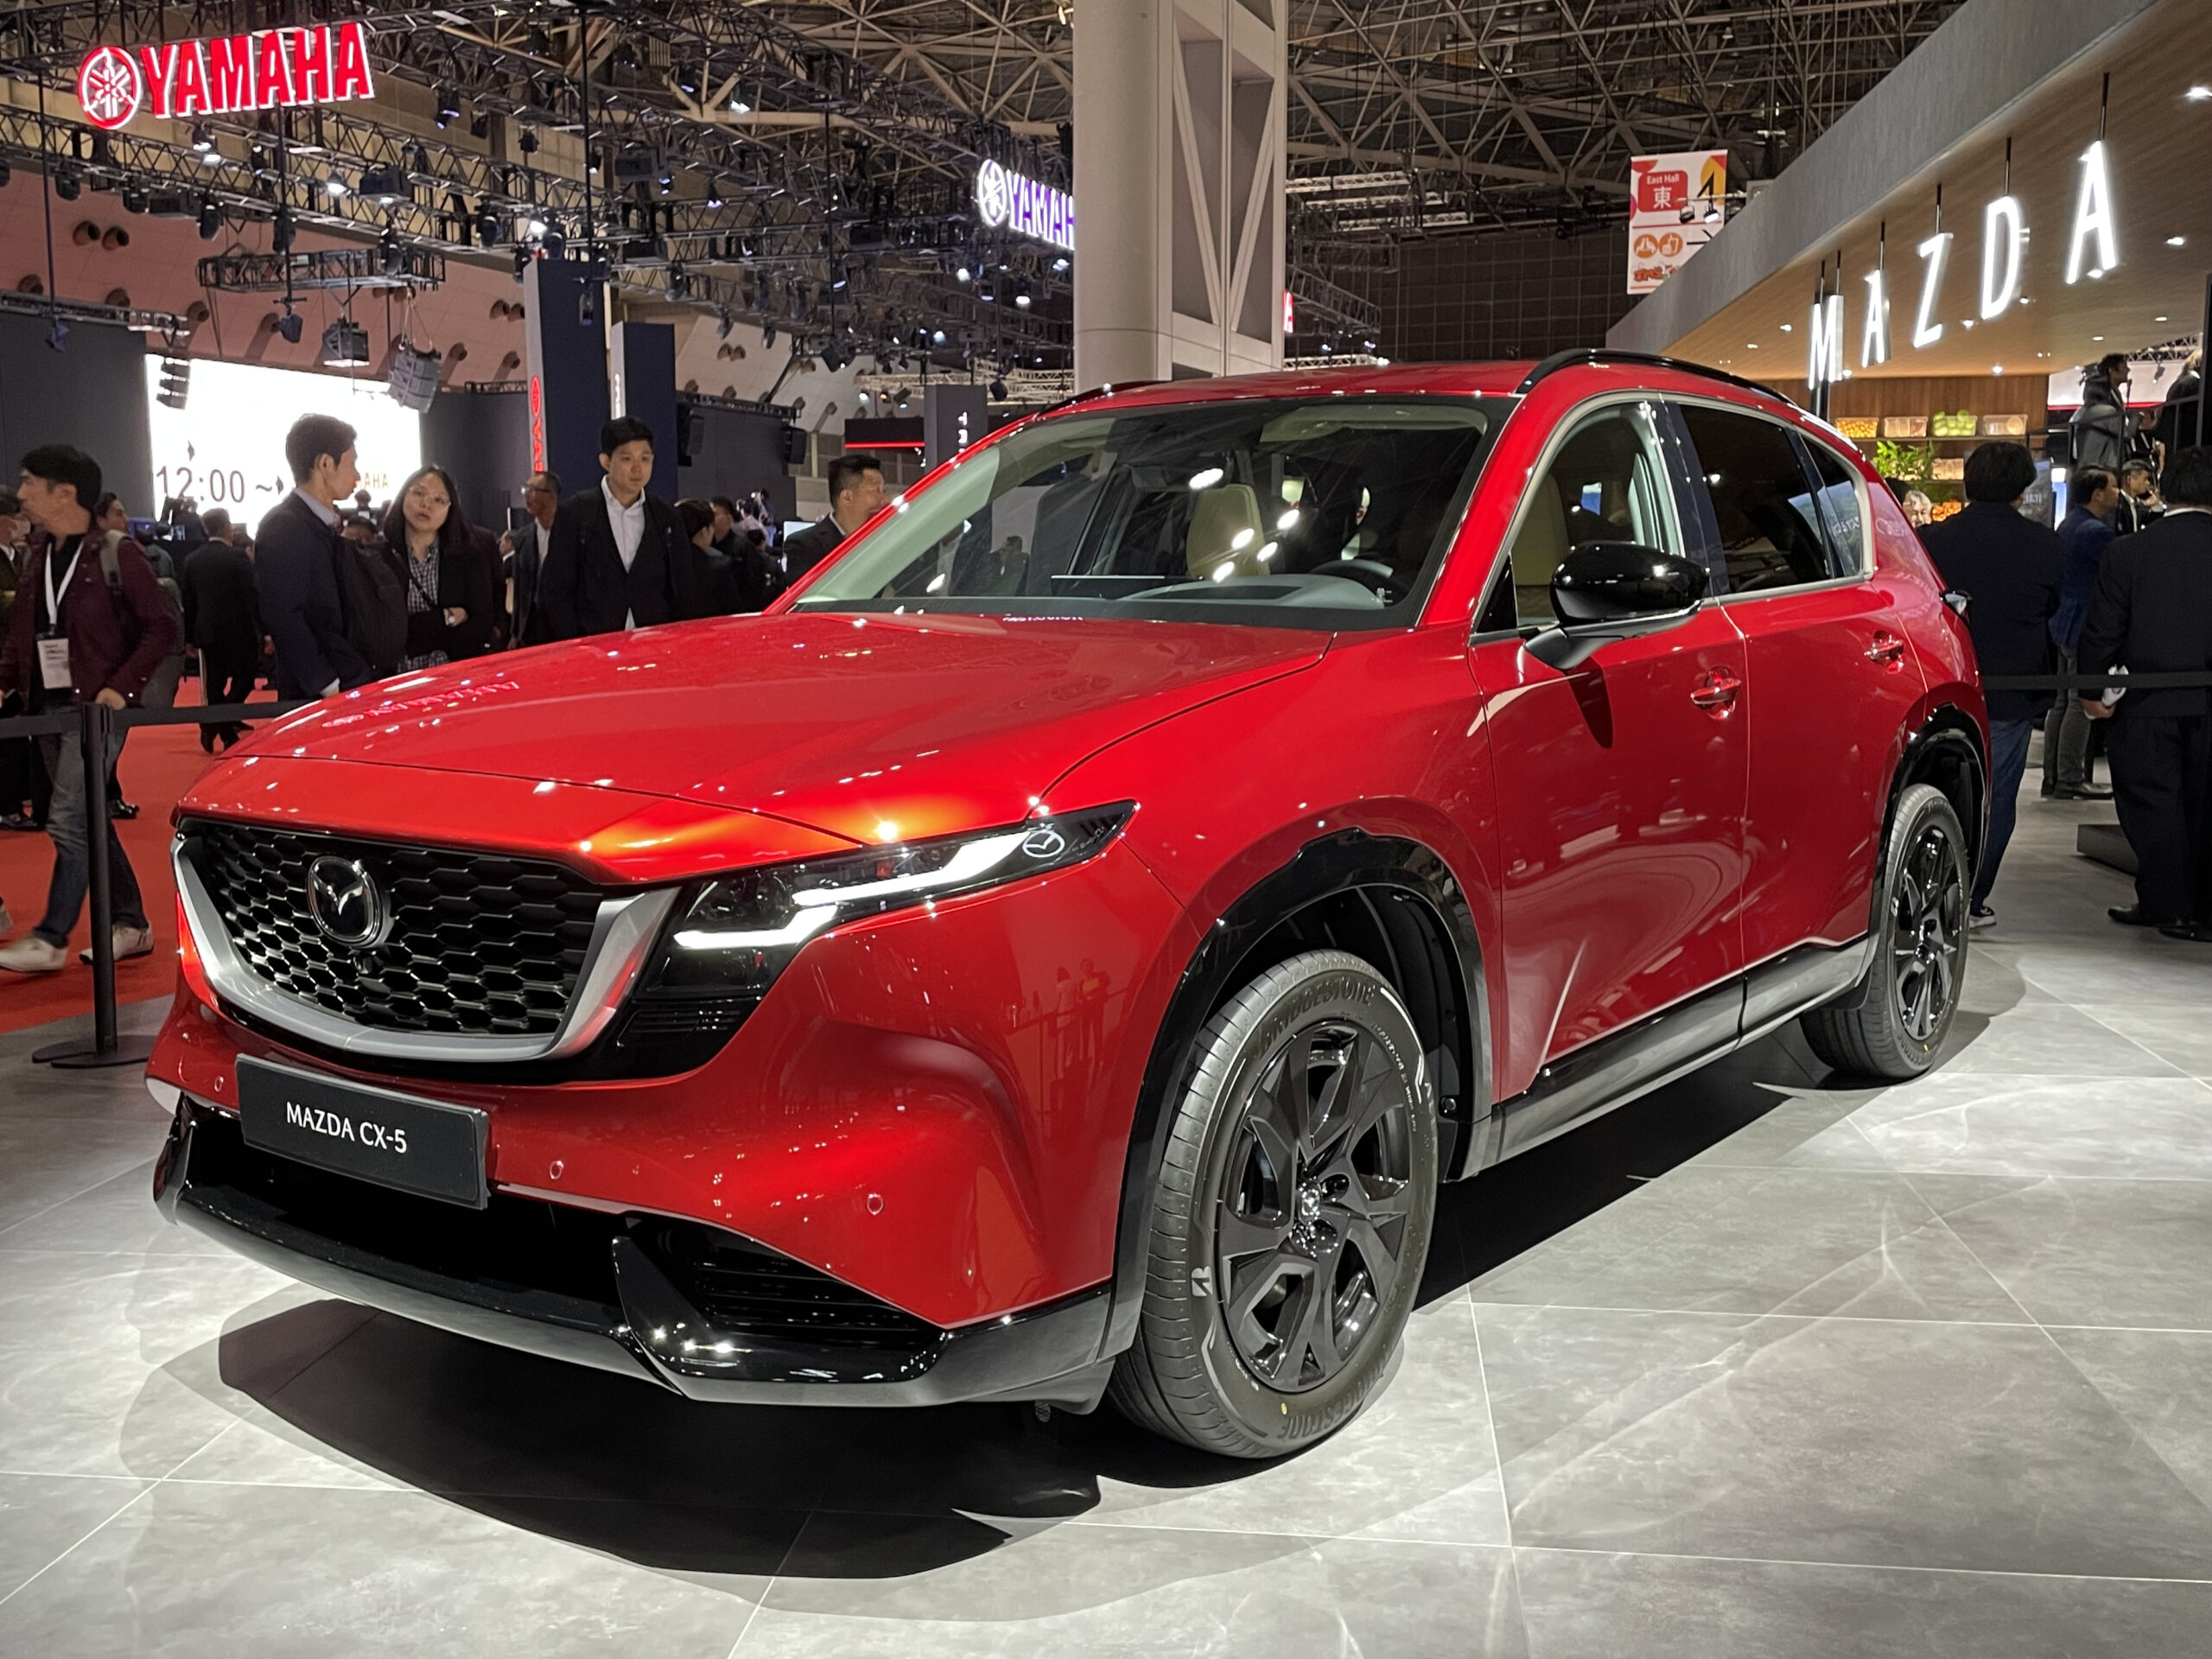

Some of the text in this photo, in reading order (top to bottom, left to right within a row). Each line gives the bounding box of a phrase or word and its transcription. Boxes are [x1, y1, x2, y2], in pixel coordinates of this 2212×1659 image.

[140, 22, 375, 118] YAMAHA
[1005, 168, 1075, 251] YAMAH
[1646, 173, 1680, 185] East Hall
[1653, 186, 1672, 209] 東
[1808, 140, 2119, 390] MAZDA
[286, 1101, 407, 1154] MAZDA CX-5
